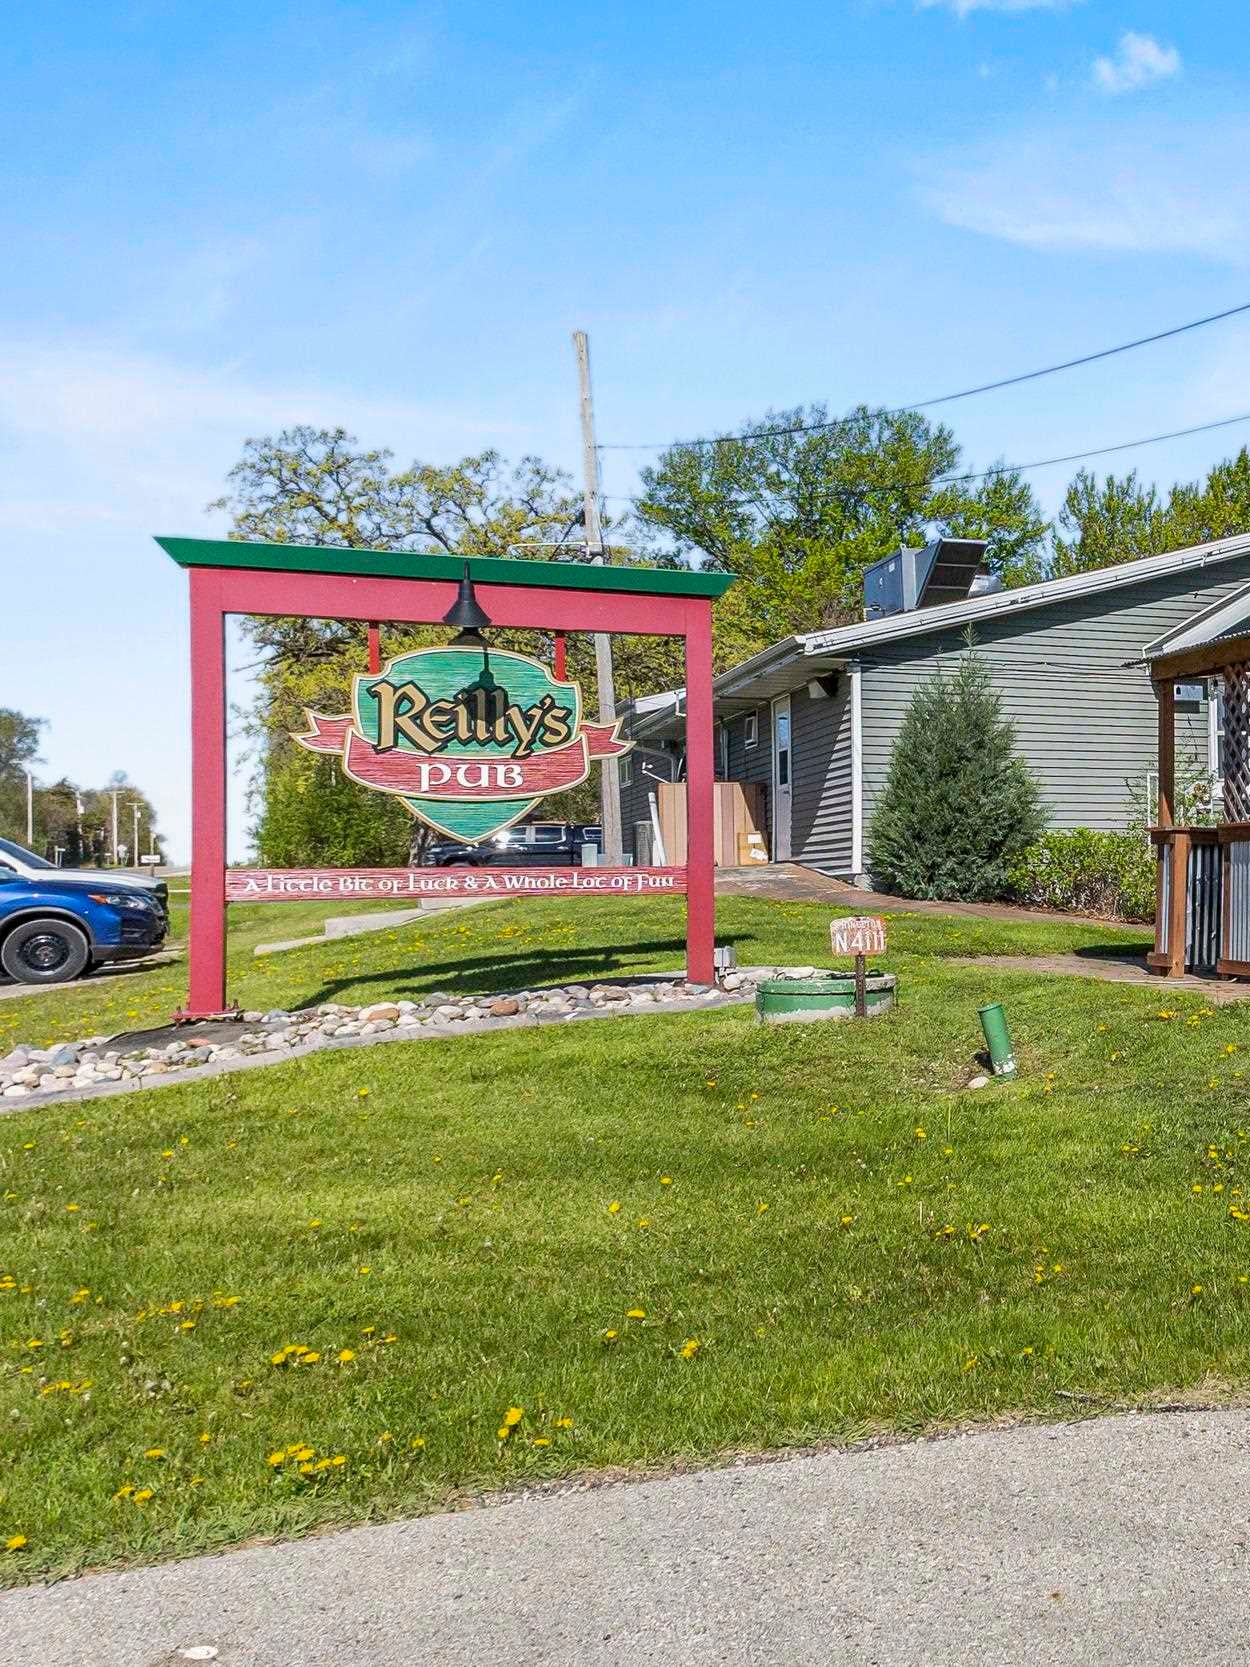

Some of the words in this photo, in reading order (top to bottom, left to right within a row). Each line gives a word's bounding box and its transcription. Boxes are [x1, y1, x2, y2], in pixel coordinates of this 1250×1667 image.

[366, 679, 572, 758] Reilly's
[245, 880, 260, 892] A
[338, 876, 373, 891] Bit
[464, 876, 477, 888] &
[486, 875, 501, 889] A
[502, 873, 568, 889] Whole
[572, 872, 607, 889] Lot
